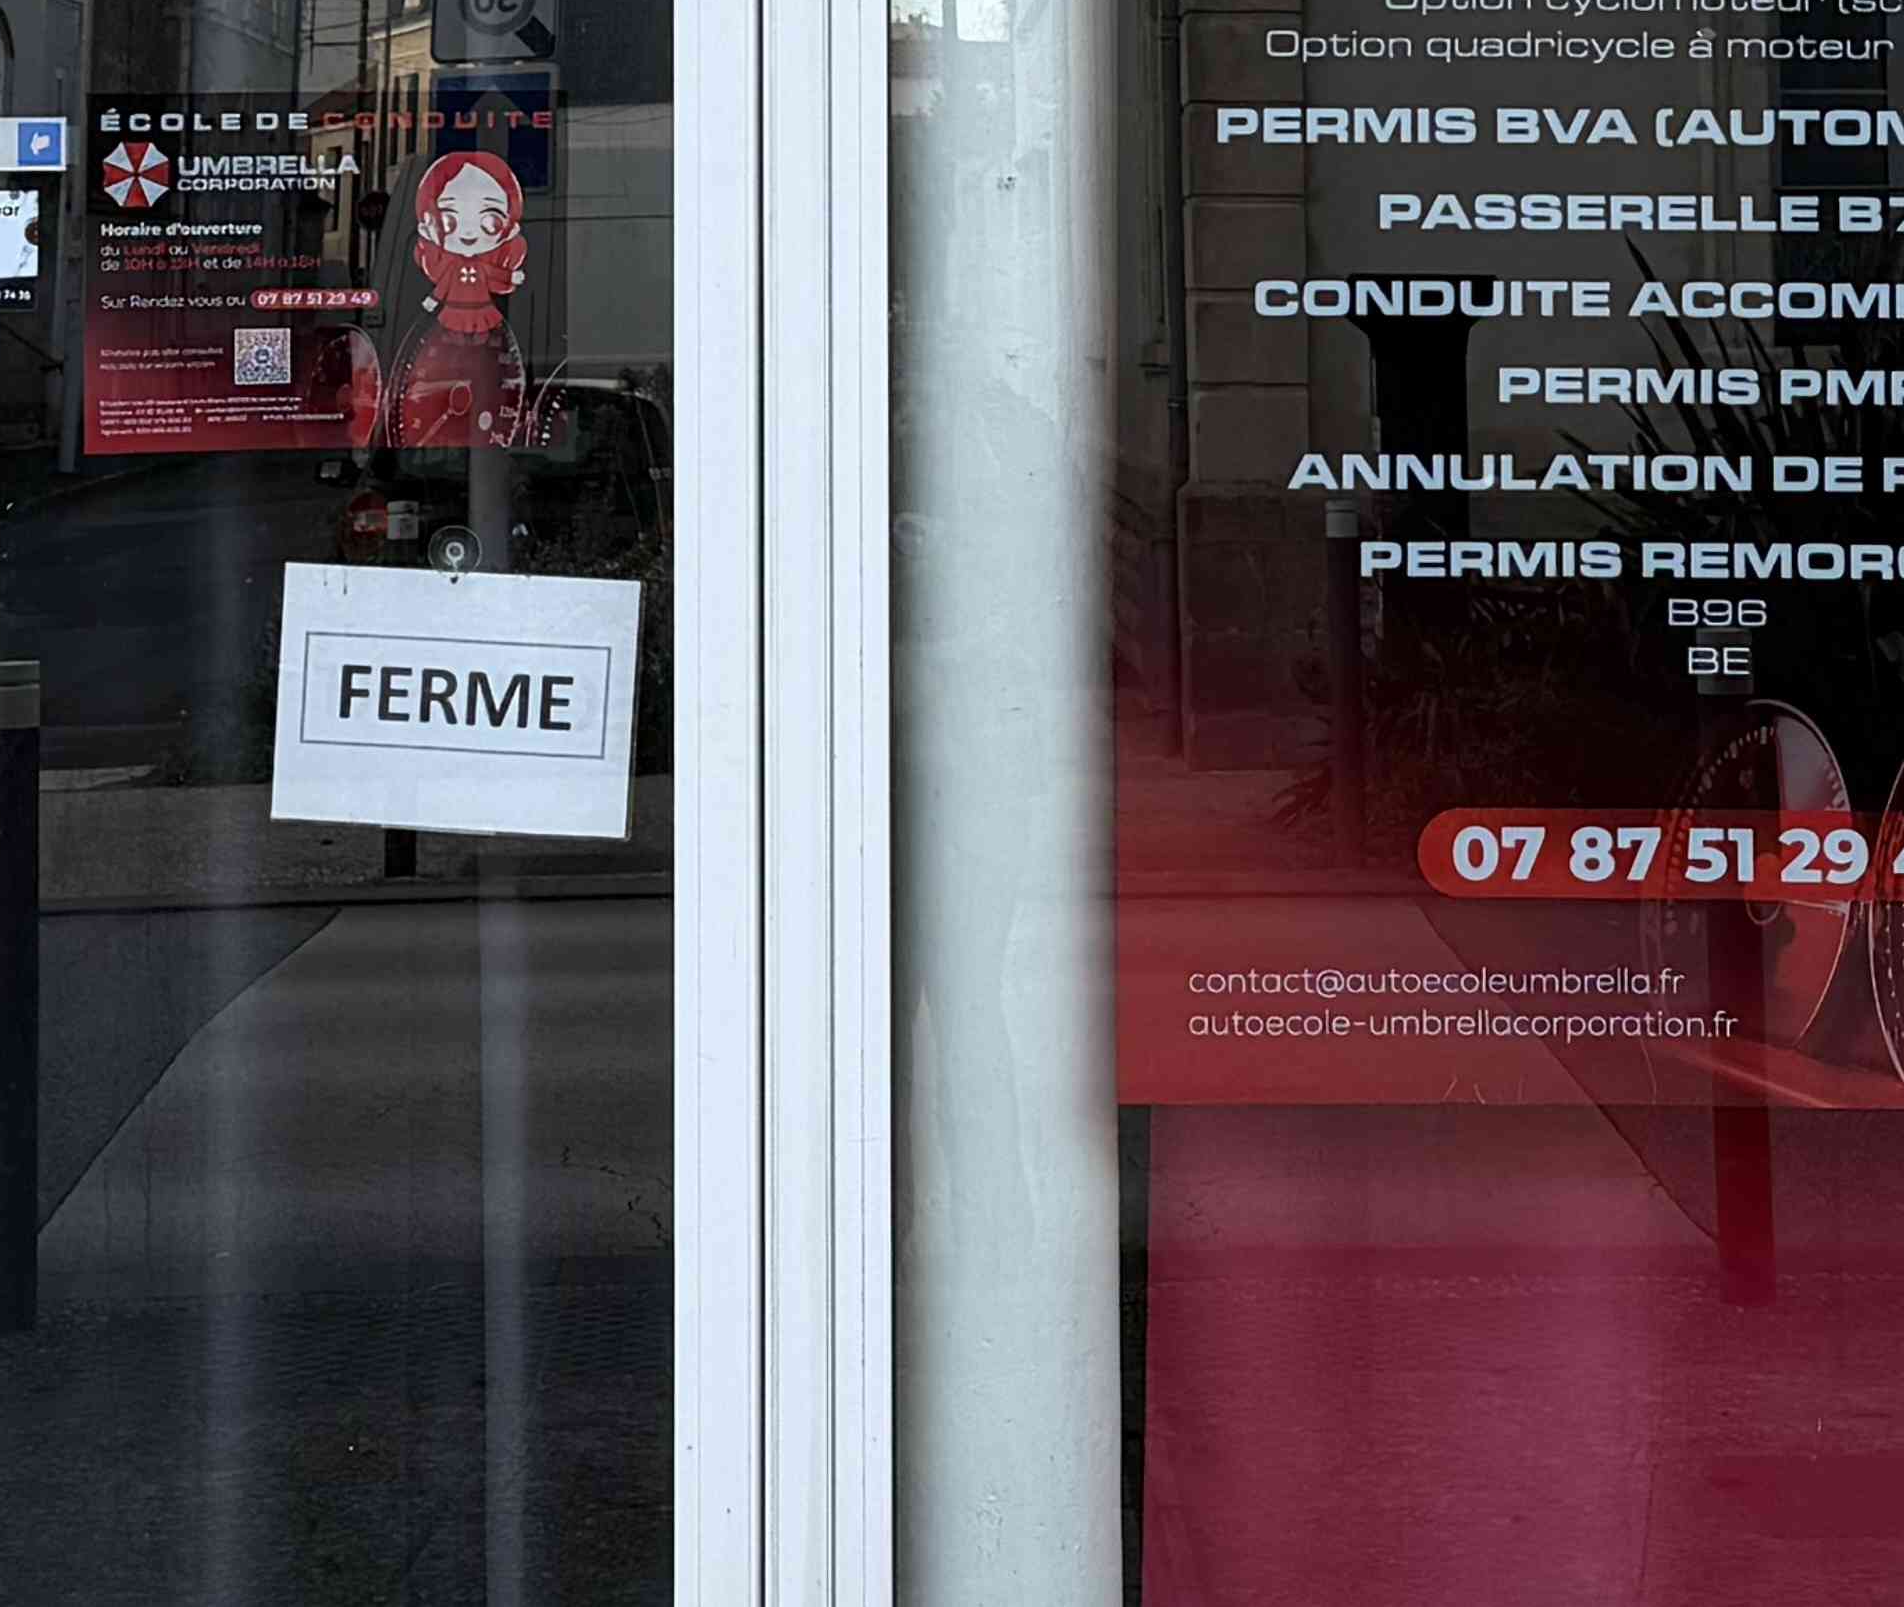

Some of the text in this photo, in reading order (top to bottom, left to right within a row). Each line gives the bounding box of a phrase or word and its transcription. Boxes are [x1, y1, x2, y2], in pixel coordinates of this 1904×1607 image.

[1264, 28, 1415, 64] Option
[1423, 30, 1677, 64] quadricycle
[1687, 28, 1717, 59] à
[1726, 35, 1896, 63] moteur
[100, 108, 554, 132] ÉCOLE DE CONDUITE
[1215, 107, 1478, 145] PERMIS
[1495, 107, 1638, 147] BVA
[178, 154, 361, 175] UMBRELLA
[177, 175, 336, 191] CORPORATION
[101, 222, 263, 236] Horaire d'ouverture
[1378, 193, 1821, 233] PASSERELLE
[100, 257, 241, 271] de et de
[101, 296, 126, 309] Sur
[130, 295, 184, 307] Rendez
[187, 296, 223, 307] vous
[257, 293, 277, 306] 07
[306, 293, 321, 305] 51
[350, 292, 371, 304] 49
[1253, 278, 1612, 320] CONDUITE
[1497, 368, 1762, 406] PERMIS
[1287, 454, 1755, 493] ANNULATION
[1773, 455, 1865, 493] DE
[1360, 540, 1623, 579] PERMIS
[1666, 598, 1769, 627] B96
[1687, 648, 1752, 675] BE
[339, 663, 574, 731] FERME
[1451, 823, 1548, 882] 07
[1568, 825, 1660, 882] 87
[1686, 826, 1758, 881] 51
[1779, 826, 1869, 884] 29
[1188, 965, 1685, 999] contact@autoecoleumbrella.fr
[1188, 1008, 1738, 1043] autoecole-umbrellacorporation.fr
